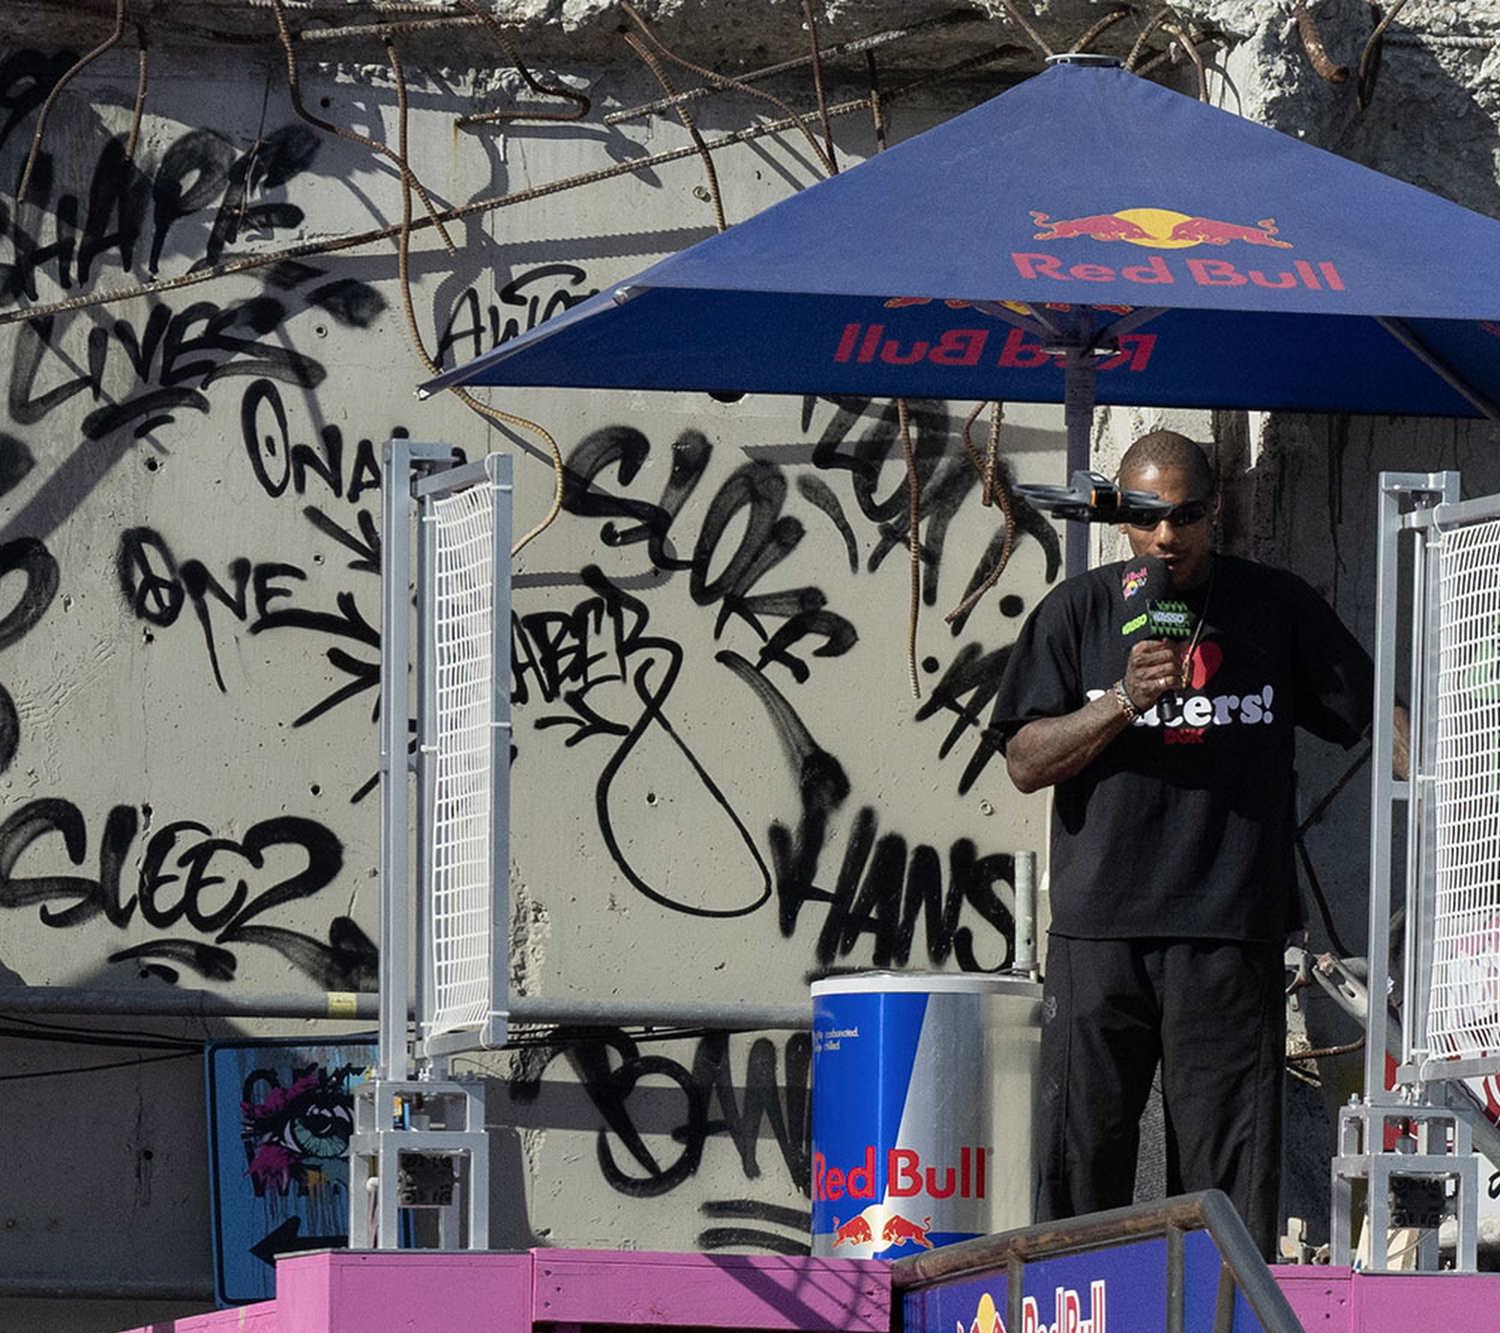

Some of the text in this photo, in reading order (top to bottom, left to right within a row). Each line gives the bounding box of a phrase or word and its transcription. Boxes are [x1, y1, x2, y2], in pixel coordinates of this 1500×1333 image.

[1010, 252, 1347, 292] Red Bull
[813, 1146, 986, 1202] Red Bull
